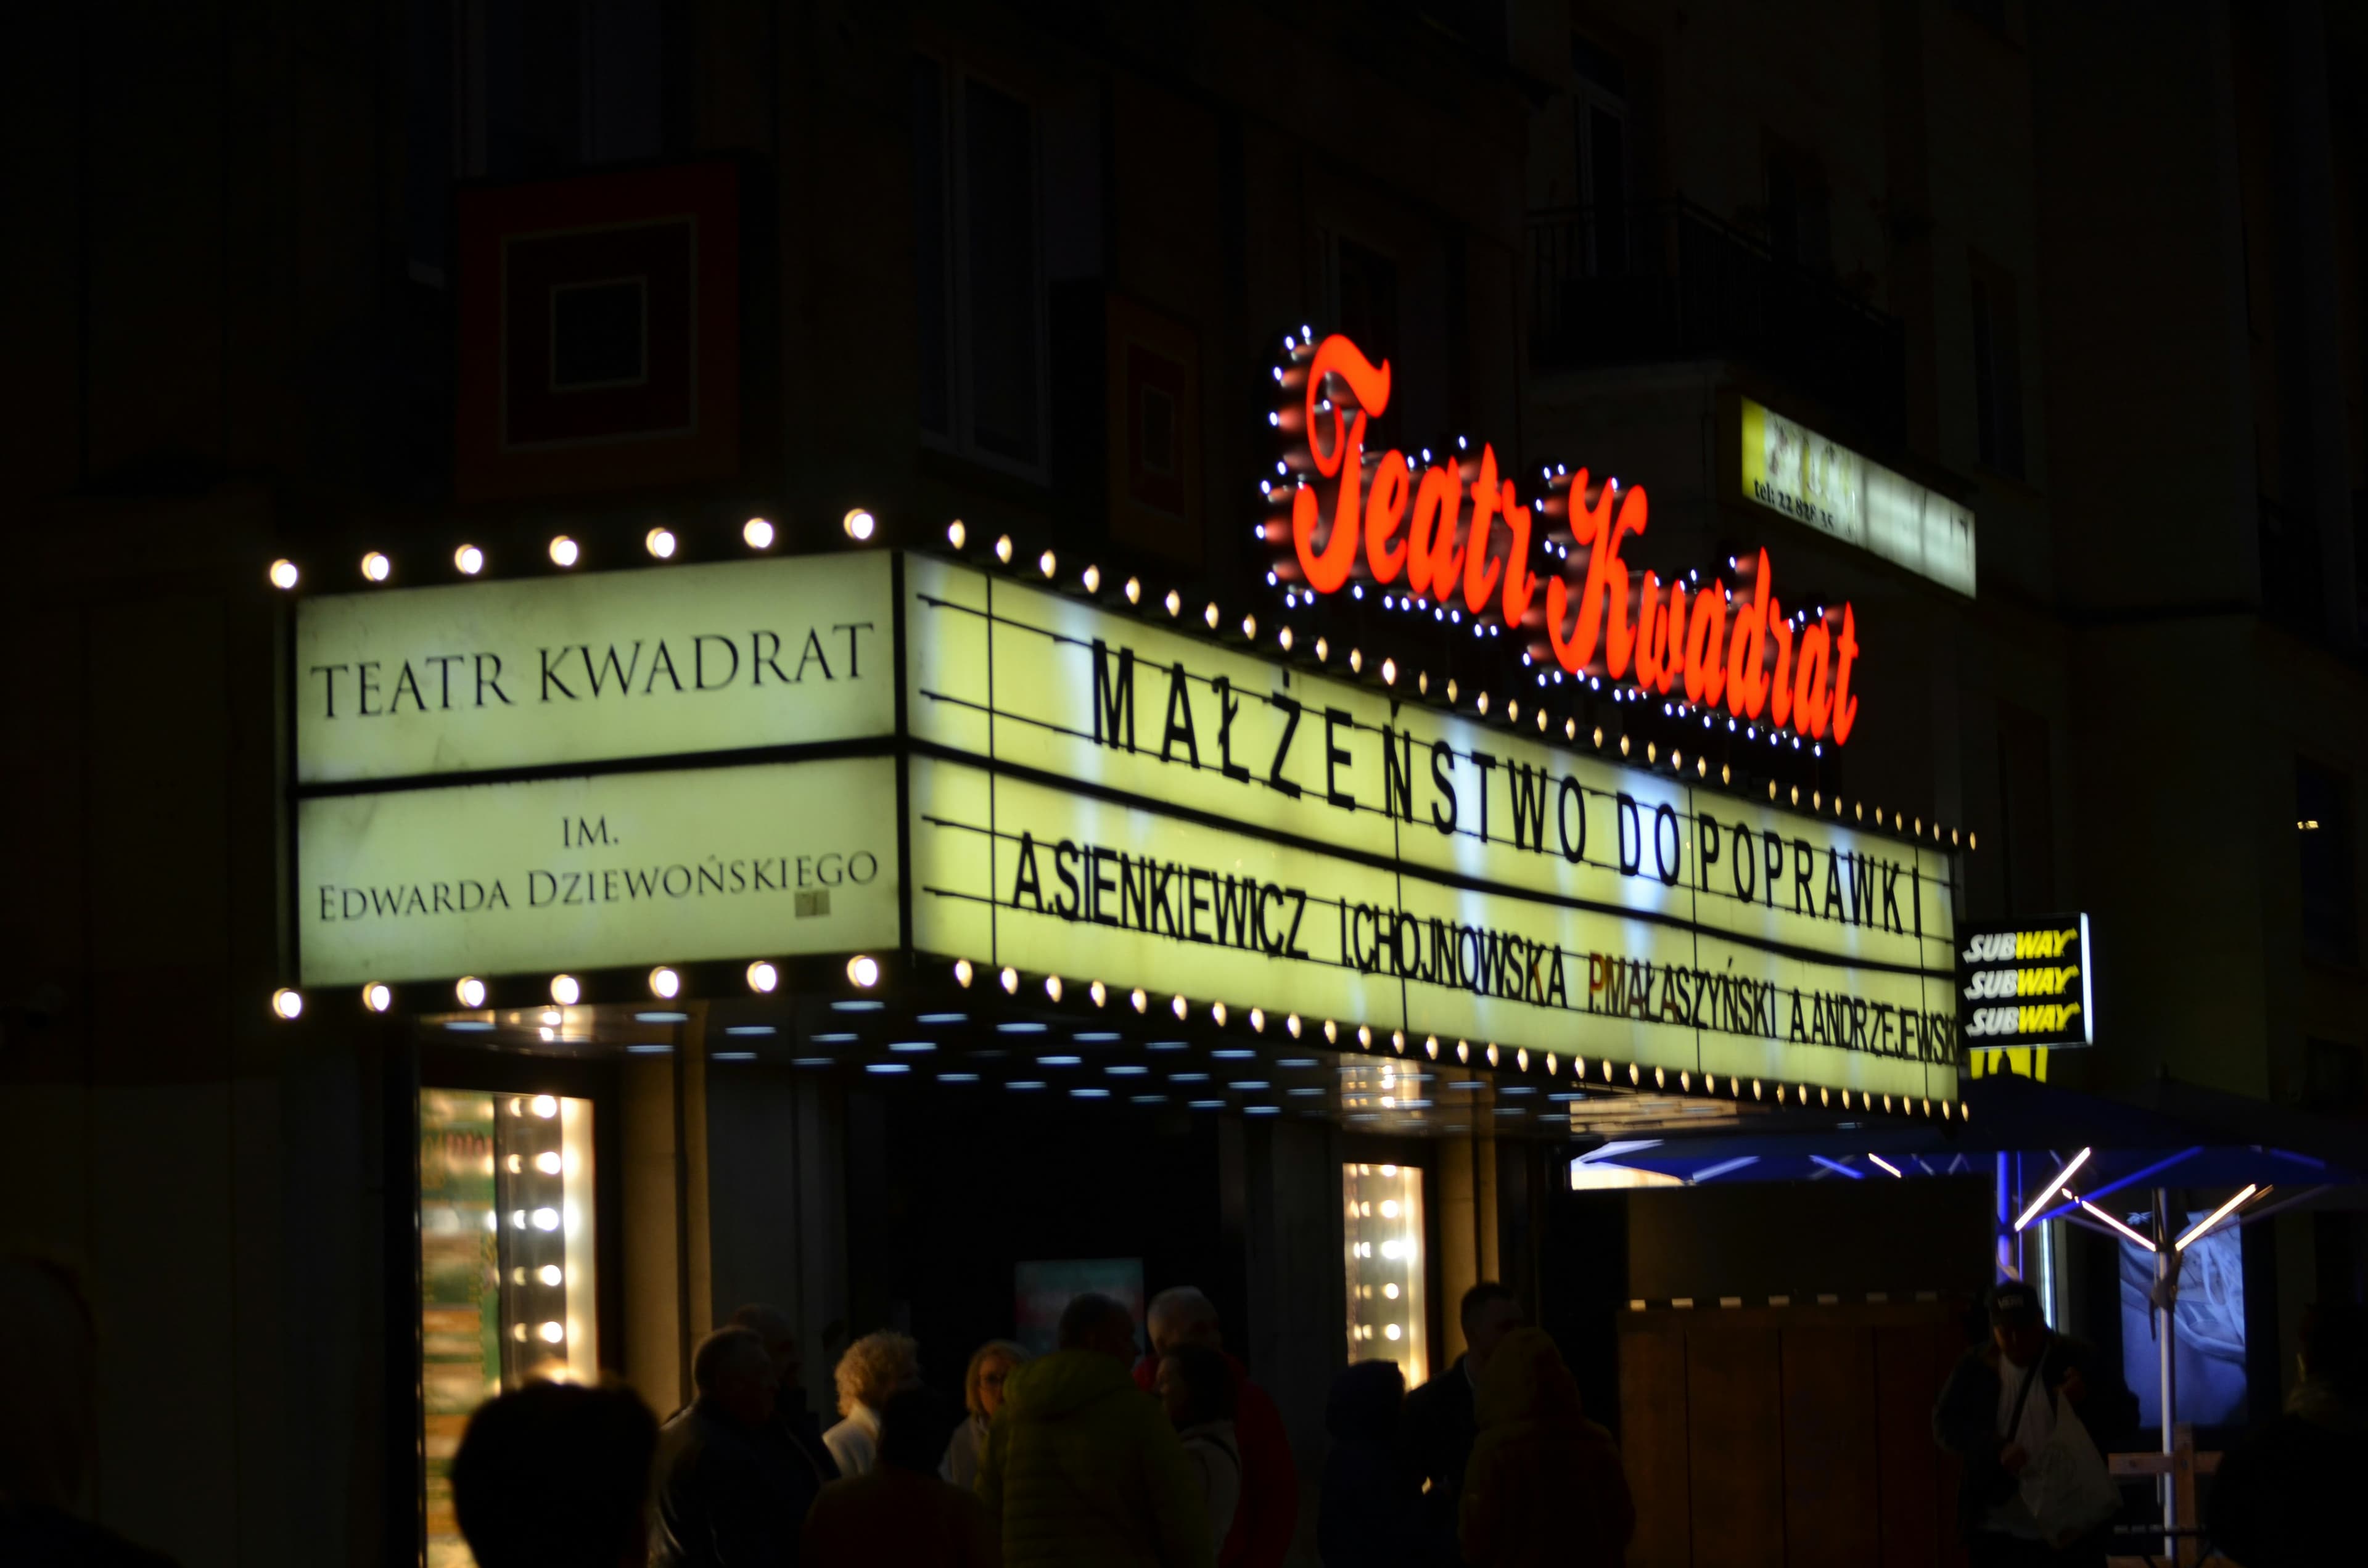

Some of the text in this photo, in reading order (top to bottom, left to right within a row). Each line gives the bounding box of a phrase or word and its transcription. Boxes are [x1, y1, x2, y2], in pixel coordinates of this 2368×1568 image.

[1293, 334, 1859, 746] Teatr Kwadrat
[310, 623, 874, 720] TEATR KWADRAT
[1092, 638, 1922, 938] MAŁŻEŃSTWO DO POPRAWKI
[562, 816, 619, 848] IM.
[318, 850, 878, 923] EDWARDA DZIEWOŃSKIEGO
[1012, 831, 1308, 961] A.SIENKIEWICZ
[1962, 927, 2078, 964] SUBWAY
[1963, 964, 2080, 1001] SUBWAY
[1965, 1001, 2081, 1037] SUBWAY
